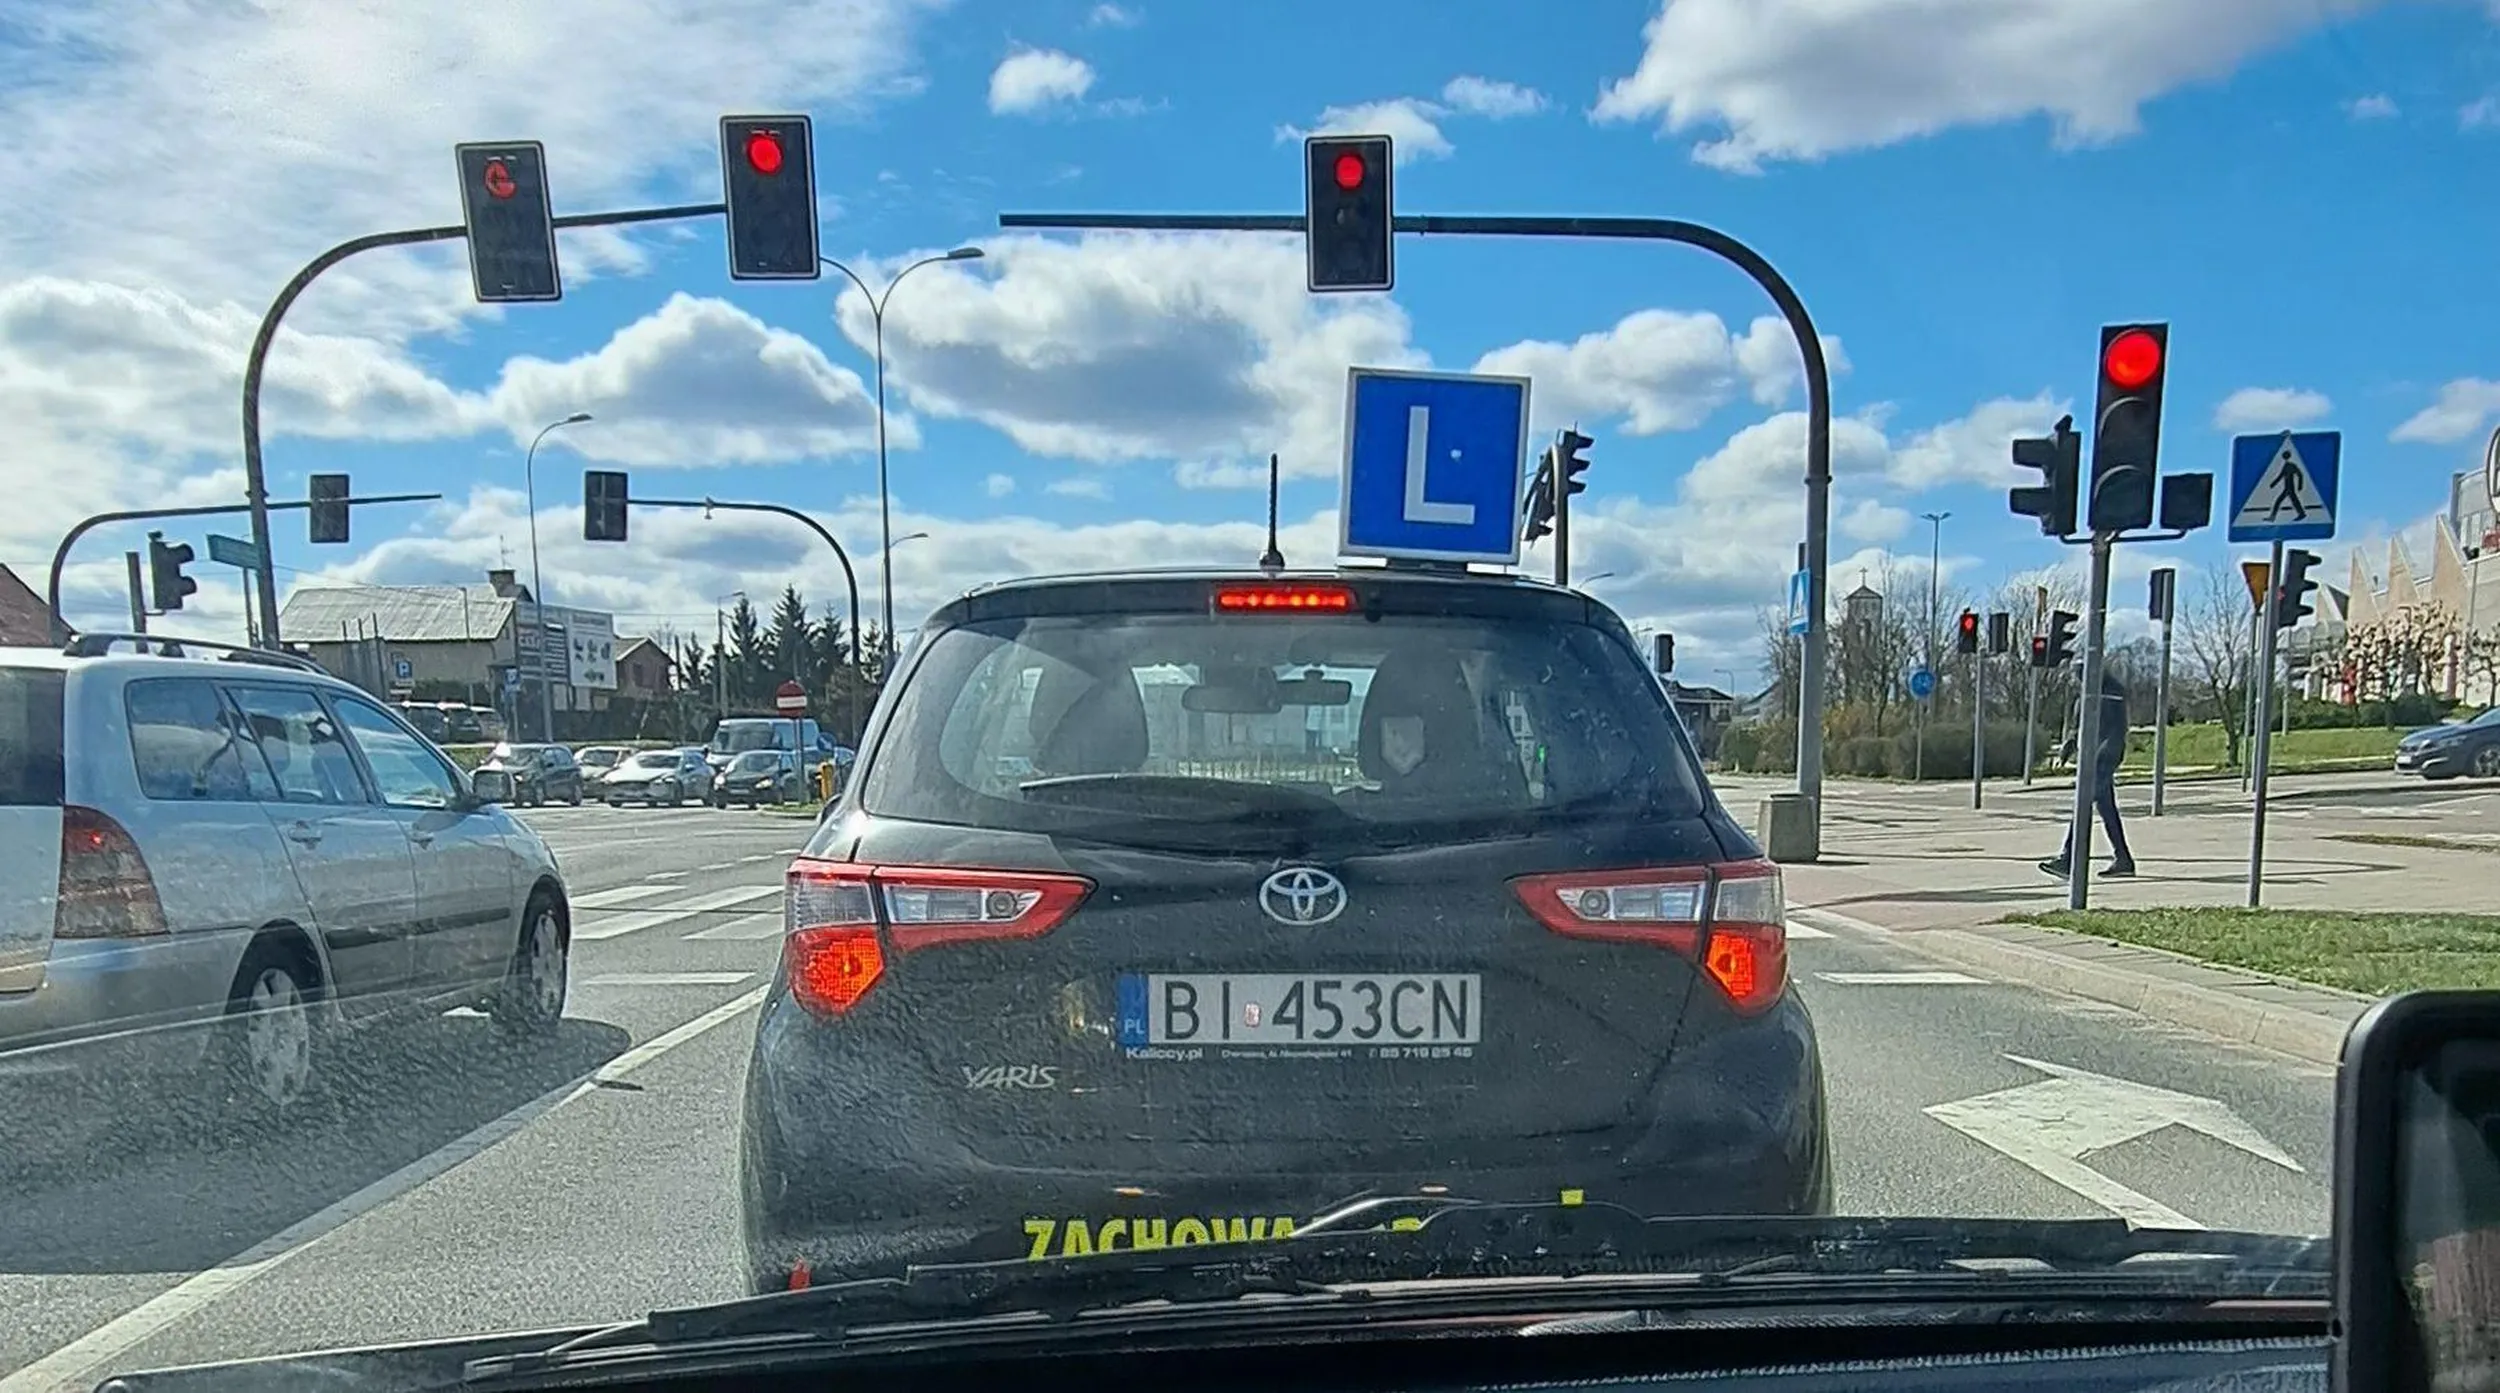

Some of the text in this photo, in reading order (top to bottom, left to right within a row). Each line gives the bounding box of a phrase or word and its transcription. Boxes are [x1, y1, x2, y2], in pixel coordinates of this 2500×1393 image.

[1403, 405, 1476, 526] L
[1272, 980, 1468, 1040] 453CN
[1124, 1018, 1145, 1035] PL
[1126, 1046, 1203, 1062] Kaliccy.pl
[961, 1063, 1060, 1089] YARIS
